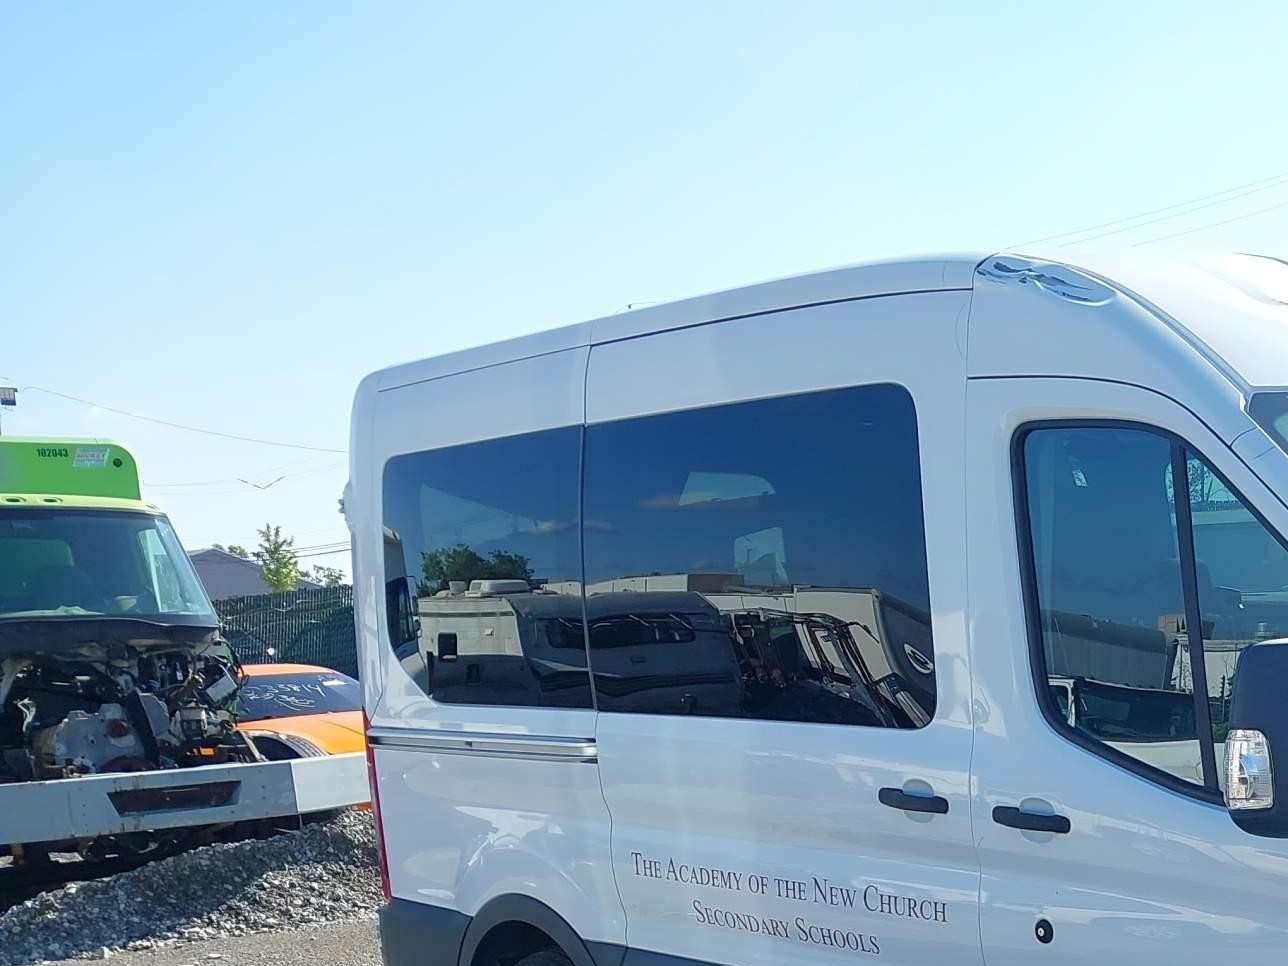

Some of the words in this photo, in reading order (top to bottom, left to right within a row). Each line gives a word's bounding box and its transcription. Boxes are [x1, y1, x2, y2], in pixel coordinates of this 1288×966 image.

[36, 447, 69, 458] 102043
[631, 852, 662, 879] THE
[666, 857, 742, 891] ACADEMY
[812, 877, 857, 909] NEW
[863, 885, 948, 923] CHURCH
[692, 899, 790, 939] SECONDARY
[795, 917, 881, 955] SCHOOLS
